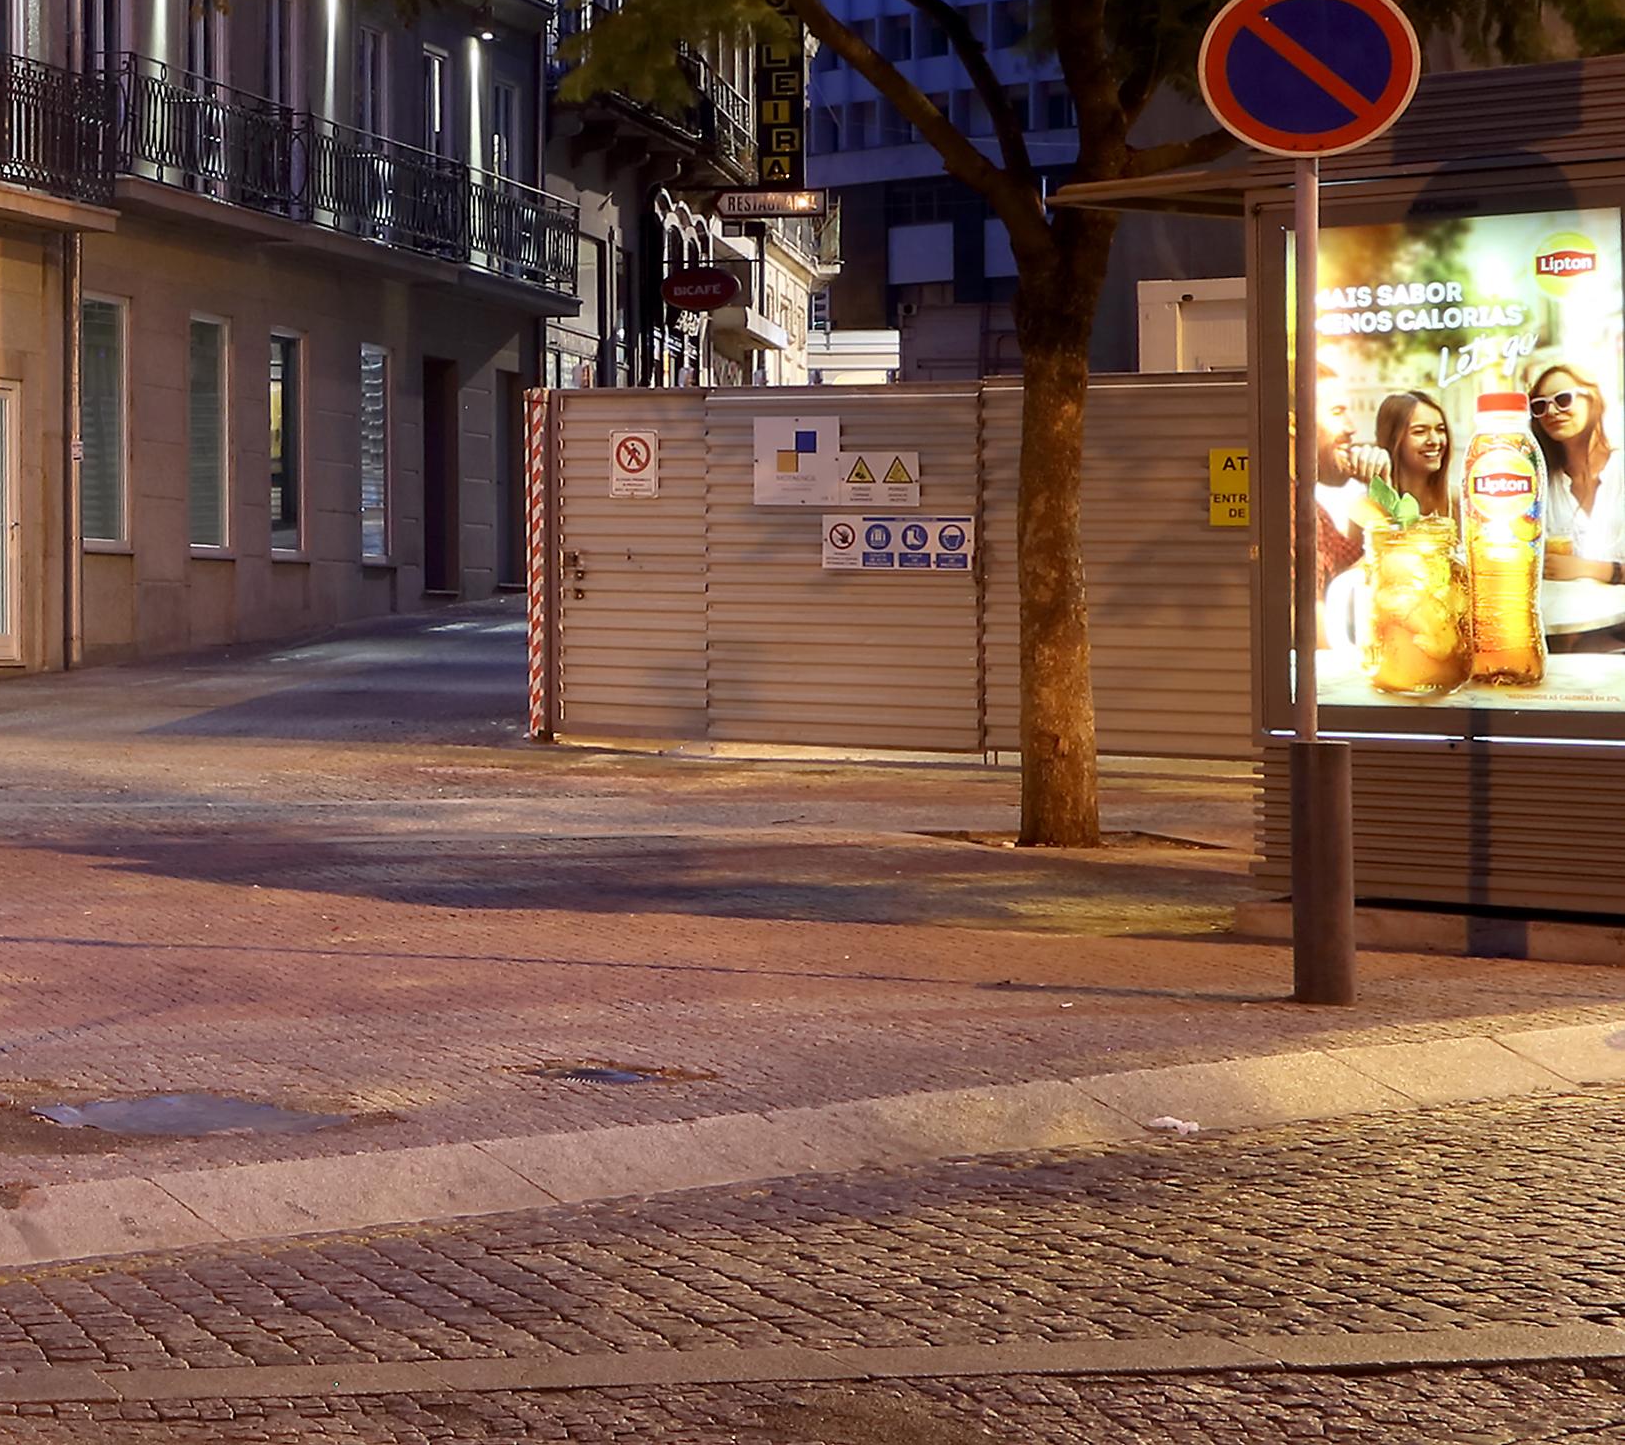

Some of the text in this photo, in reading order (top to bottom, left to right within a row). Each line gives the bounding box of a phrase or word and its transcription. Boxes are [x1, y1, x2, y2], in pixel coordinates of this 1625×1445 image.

[1540, 254, 1592, 273] Lipton
[1376, 281, 1463, 307] SABOR
[1502, 332, 1540, 377] go
[1476, 477, 1529, 495] Lipton
[1228, 508, 1246, 518] DE
